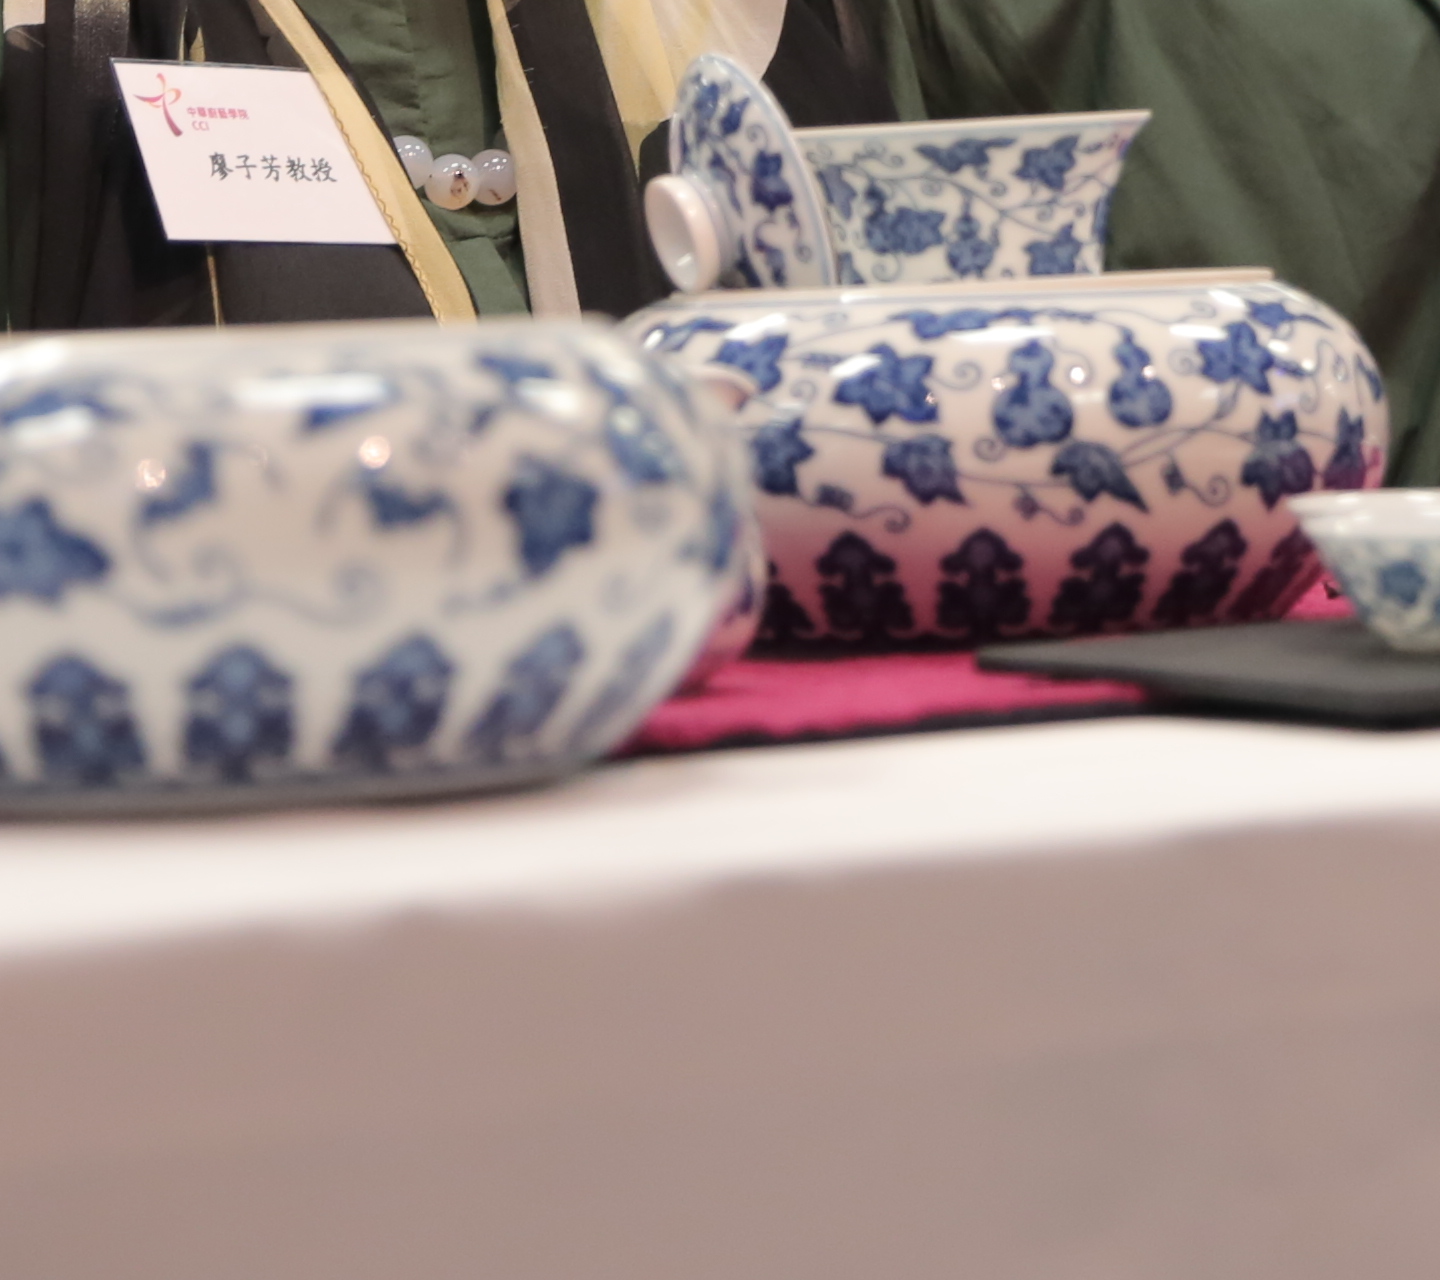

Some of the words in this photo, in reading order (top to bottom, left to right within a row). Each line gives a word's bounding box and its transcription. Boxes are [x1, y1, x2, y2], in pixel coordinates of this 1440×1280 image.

[209, 151, 338, 182] 廖子芳教授
